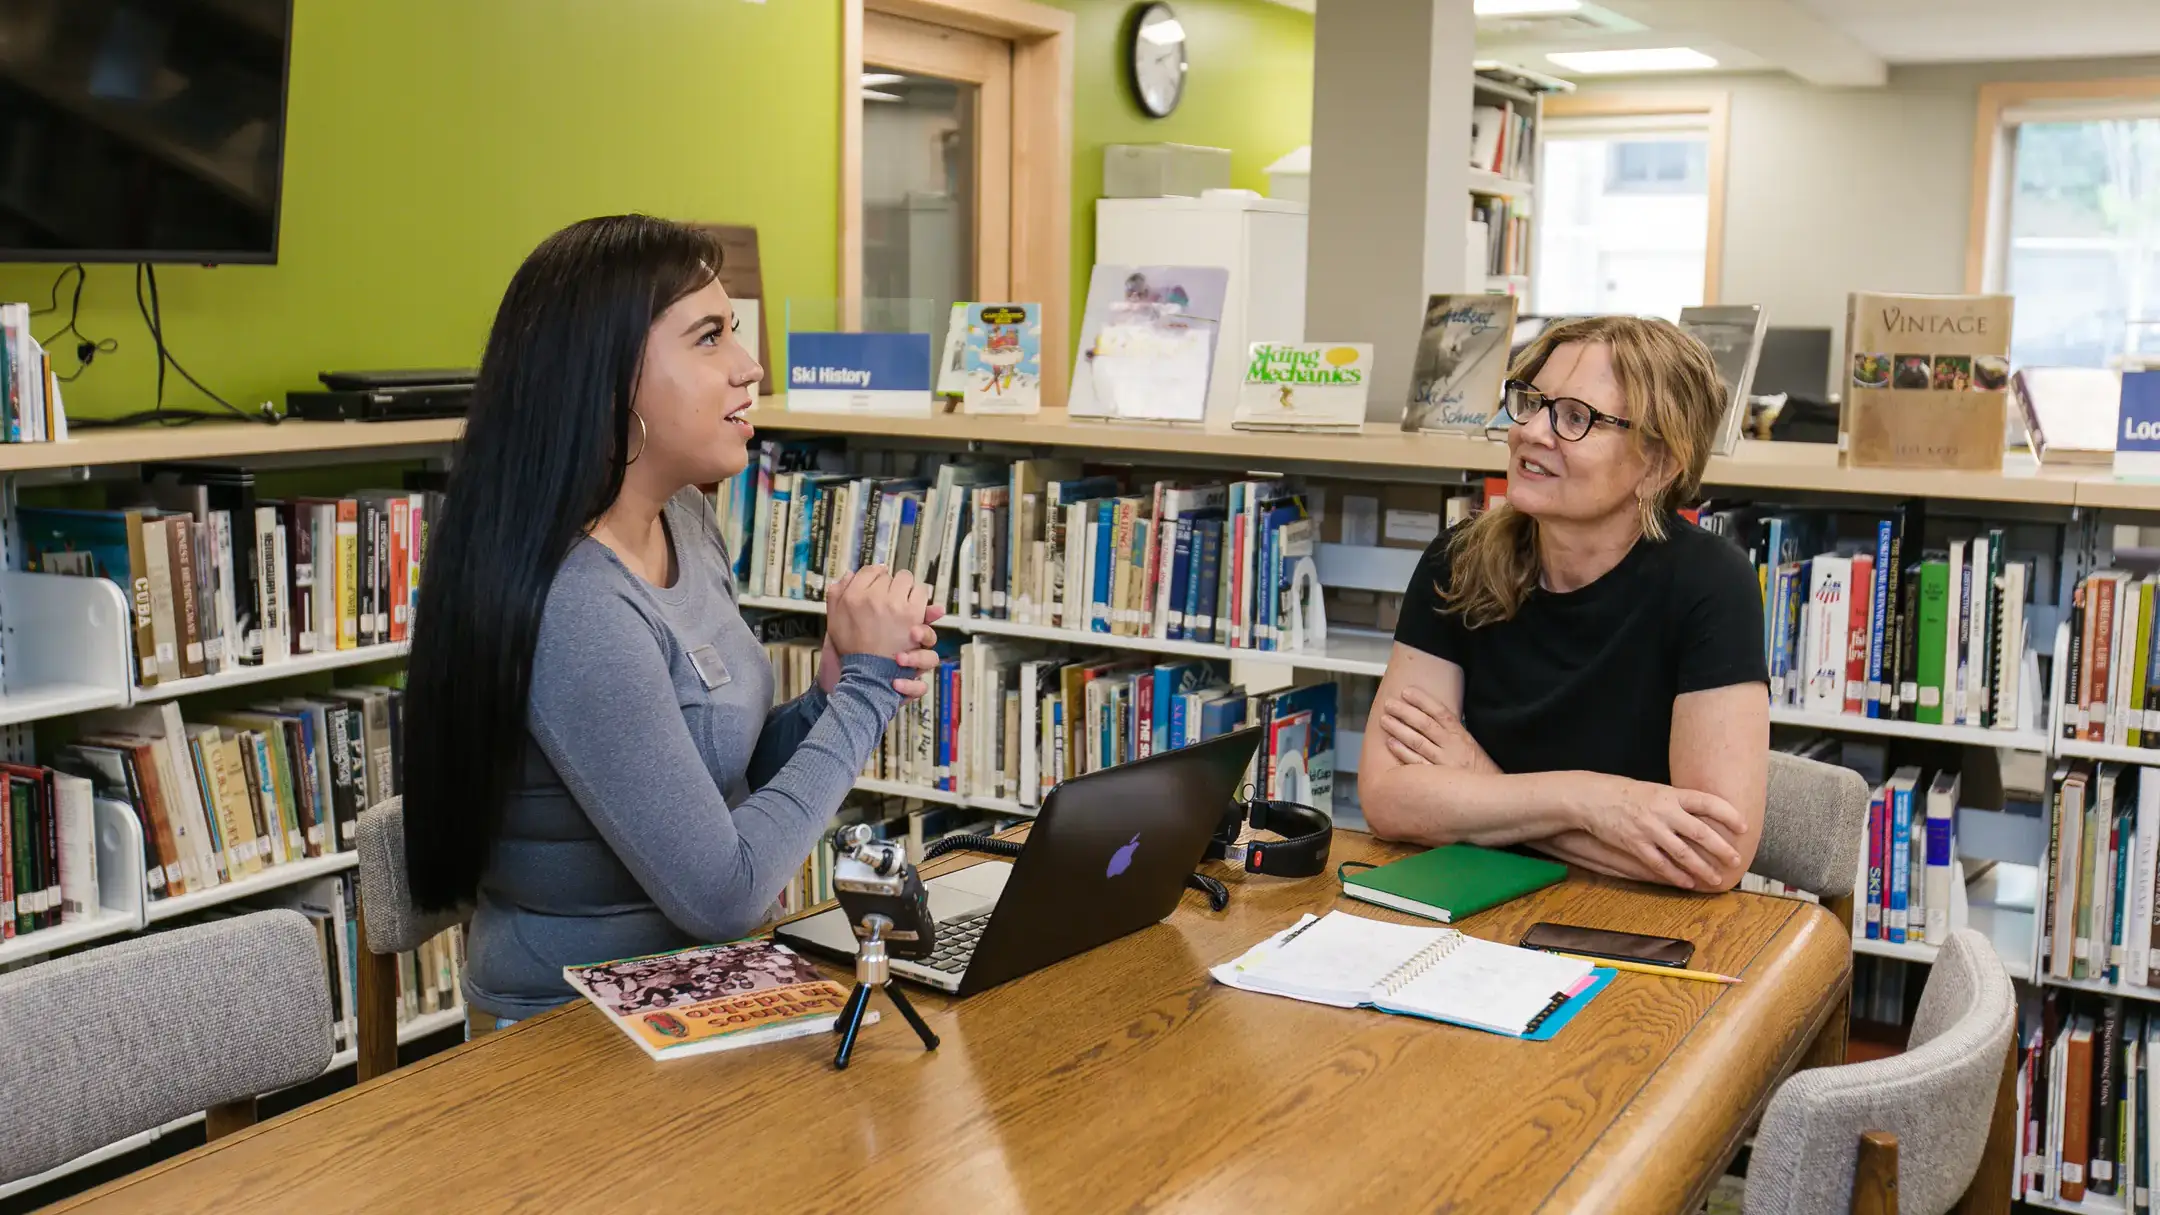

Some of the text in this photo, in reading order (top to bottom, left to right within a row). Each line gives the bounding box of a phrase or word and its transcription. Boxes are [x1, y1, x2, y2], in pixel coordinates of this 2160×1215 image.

[1881, 305, 1988, 336] VINTAGE
[1246, 357, 1361, 382] Mechanics
[1254, 345, 1321, 369] Skiing
[792, 366, 871, 387] Ski History
[769, 501, 782, 566] karakoram
[1119, 504, 1130, 549] SKIING
[264, 532, 277, 595] HEMINGWAY
[135, 576, 151, 629] CUBA
[2100, 598, 2111, 637] BREAD
[2095, 647, 2107, 670] LIFE
[1139, 718, 1150, 742] THE
[332, 708, 352, 788] Hemingway
[348, 738, 366, 809] PAPA
[1868, 866, 1882, 896] SKI
[685, 993, 795, 1020] Idaho
[800, 986, 840, 998] in
[708, 998, 844, 1029] Latinos
